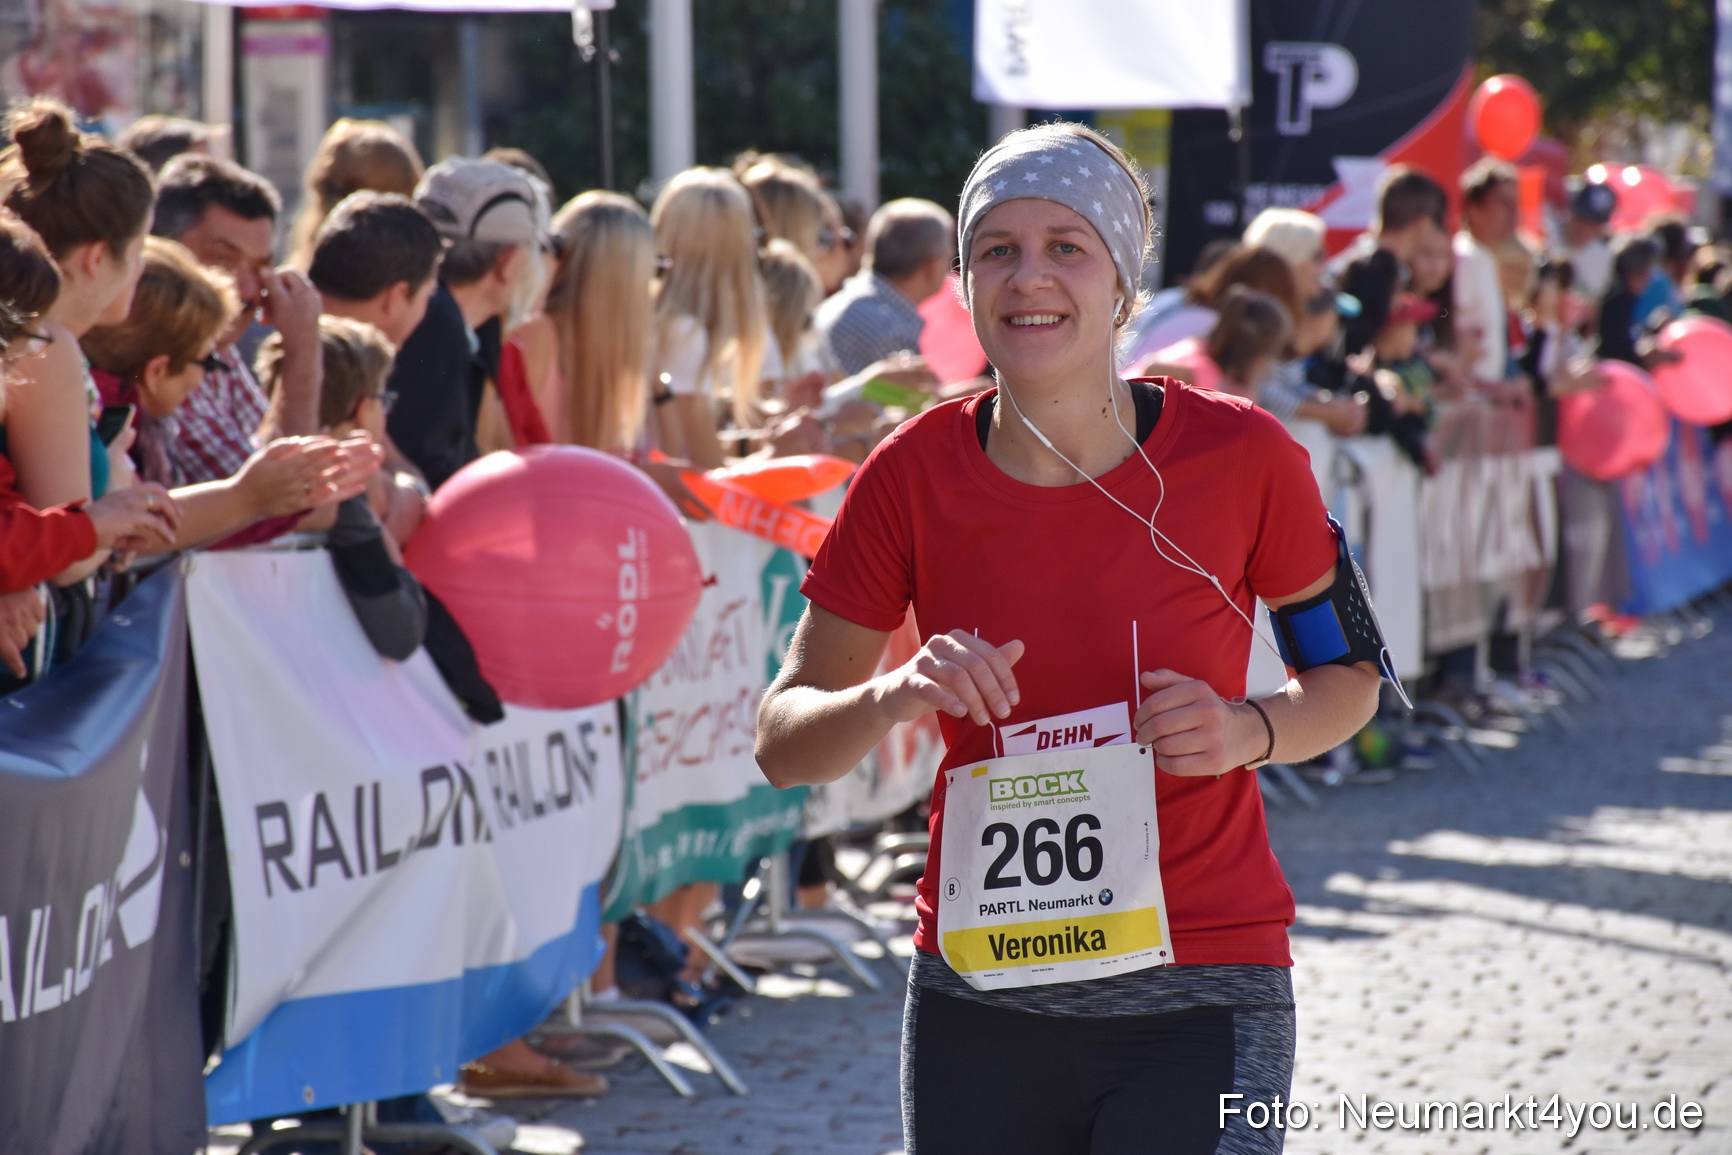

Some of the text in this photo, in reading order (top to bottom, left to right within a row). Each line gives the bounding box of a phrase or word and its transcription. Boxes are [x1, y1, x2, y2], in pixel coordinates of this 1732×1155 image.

[1036, 723, 1094, 751] DEHN
[990, 769, 1090, 803] BOCK
[990, 794, 1092, 812] inspired by smart concepts
[981, 813, 1104, 891] 266
[948, 883, 956, 896] B
[978, 894, 1094, 917] PARTL Neumarkt
[987, 925, 1108, 962] Veronika
